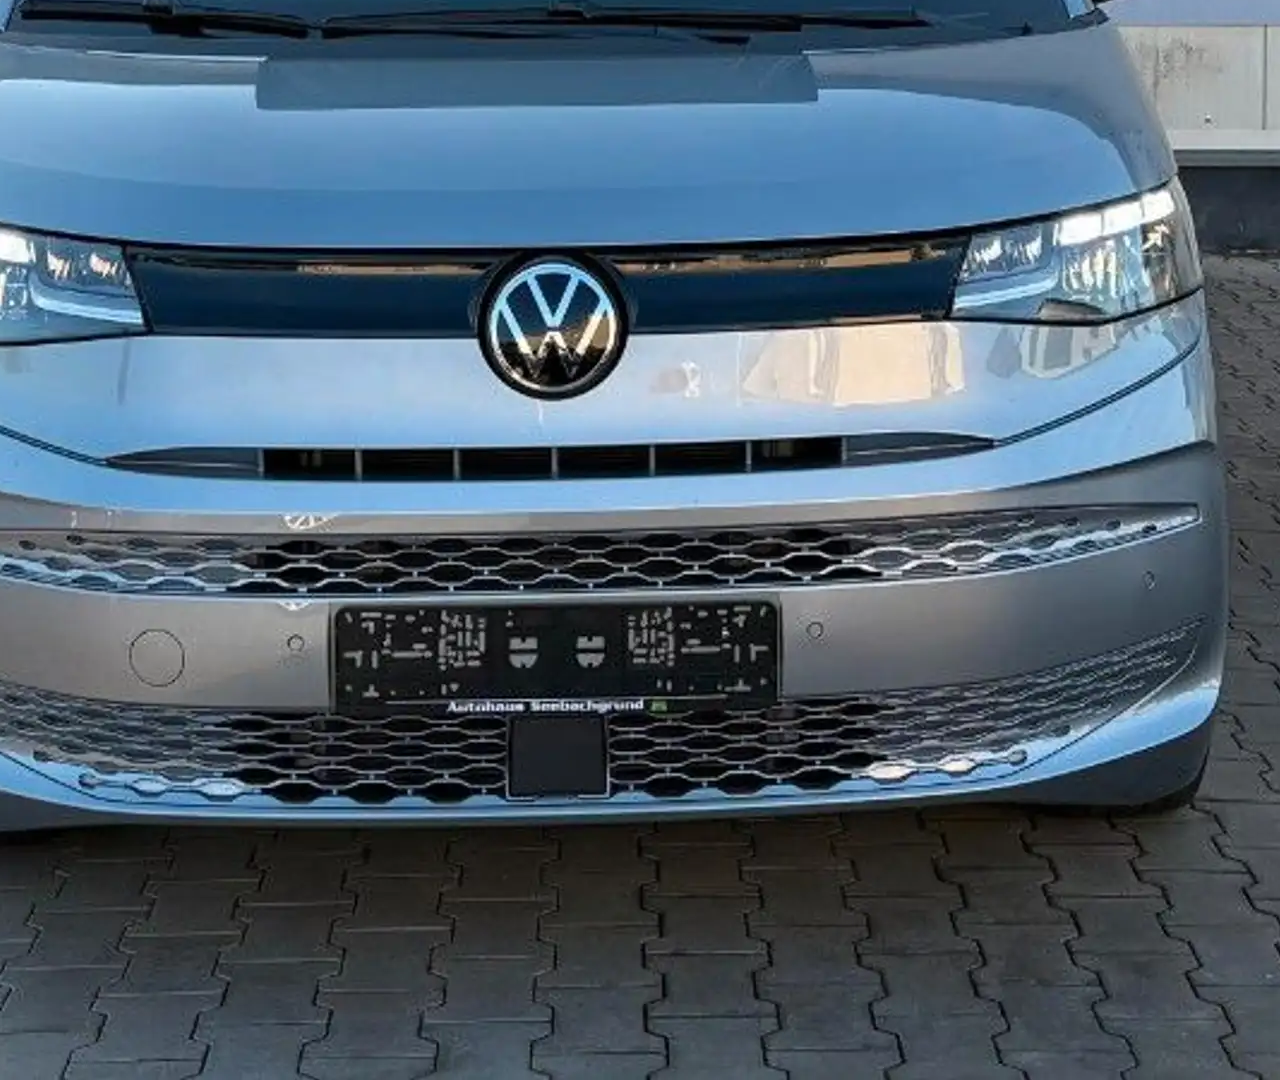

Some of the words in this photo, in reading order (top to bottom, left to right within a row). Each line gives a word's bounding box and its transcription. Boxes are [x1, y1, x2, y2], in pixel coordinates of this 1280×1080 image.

[490, 263, 617, 392] VW
[447, 701, 525, 714] Autohaus
[530, 698, 645, 714] Seebachgrund
